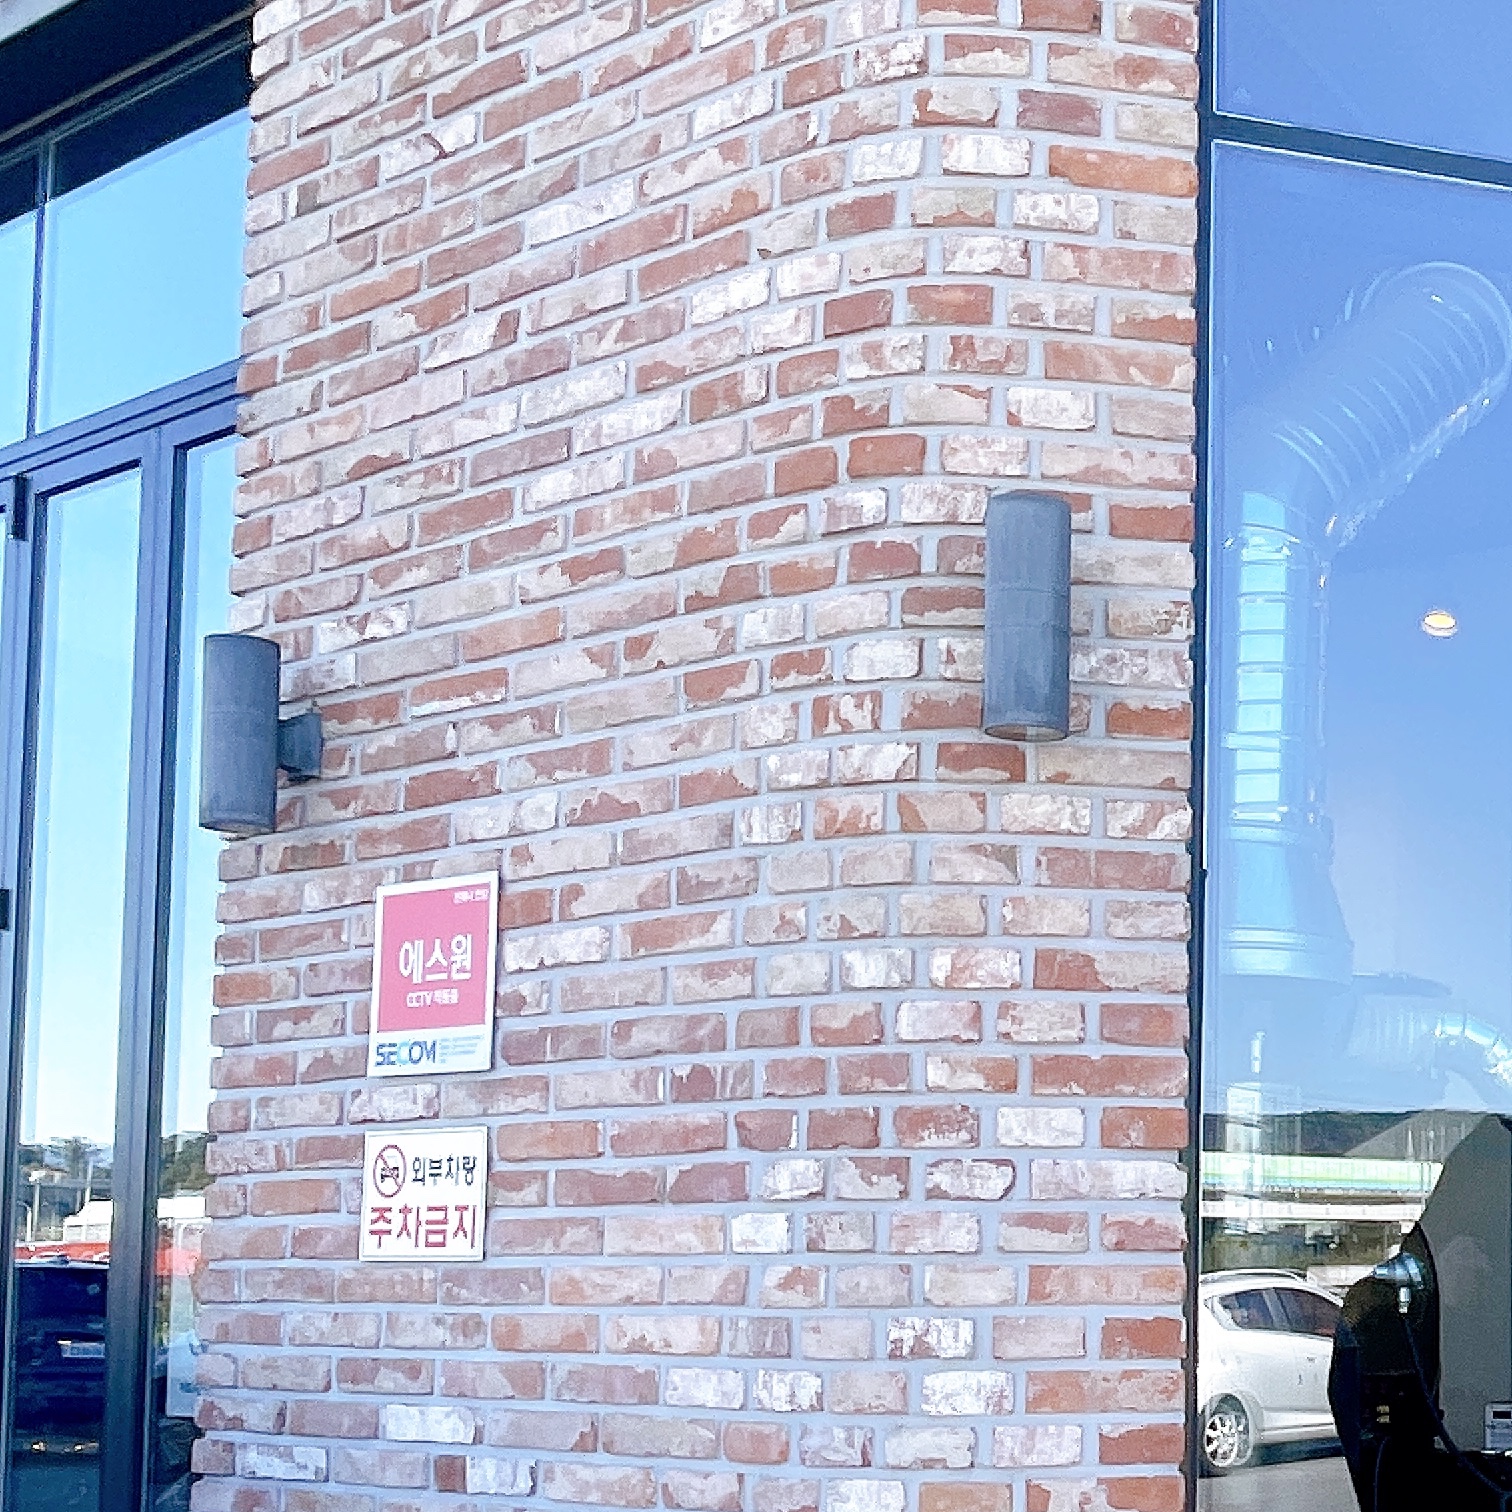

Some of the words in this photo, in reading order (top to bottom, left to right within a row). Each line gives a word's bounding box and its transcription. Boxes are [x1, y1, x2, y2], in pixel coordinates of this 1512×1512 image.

[399, 933, 472, 984] 에스원
[375, 1040, 436, 1066] SECOM
[412, 1154, 477, 1186] 외부차량
[369, 1204, 477, 1249] 주차금지
